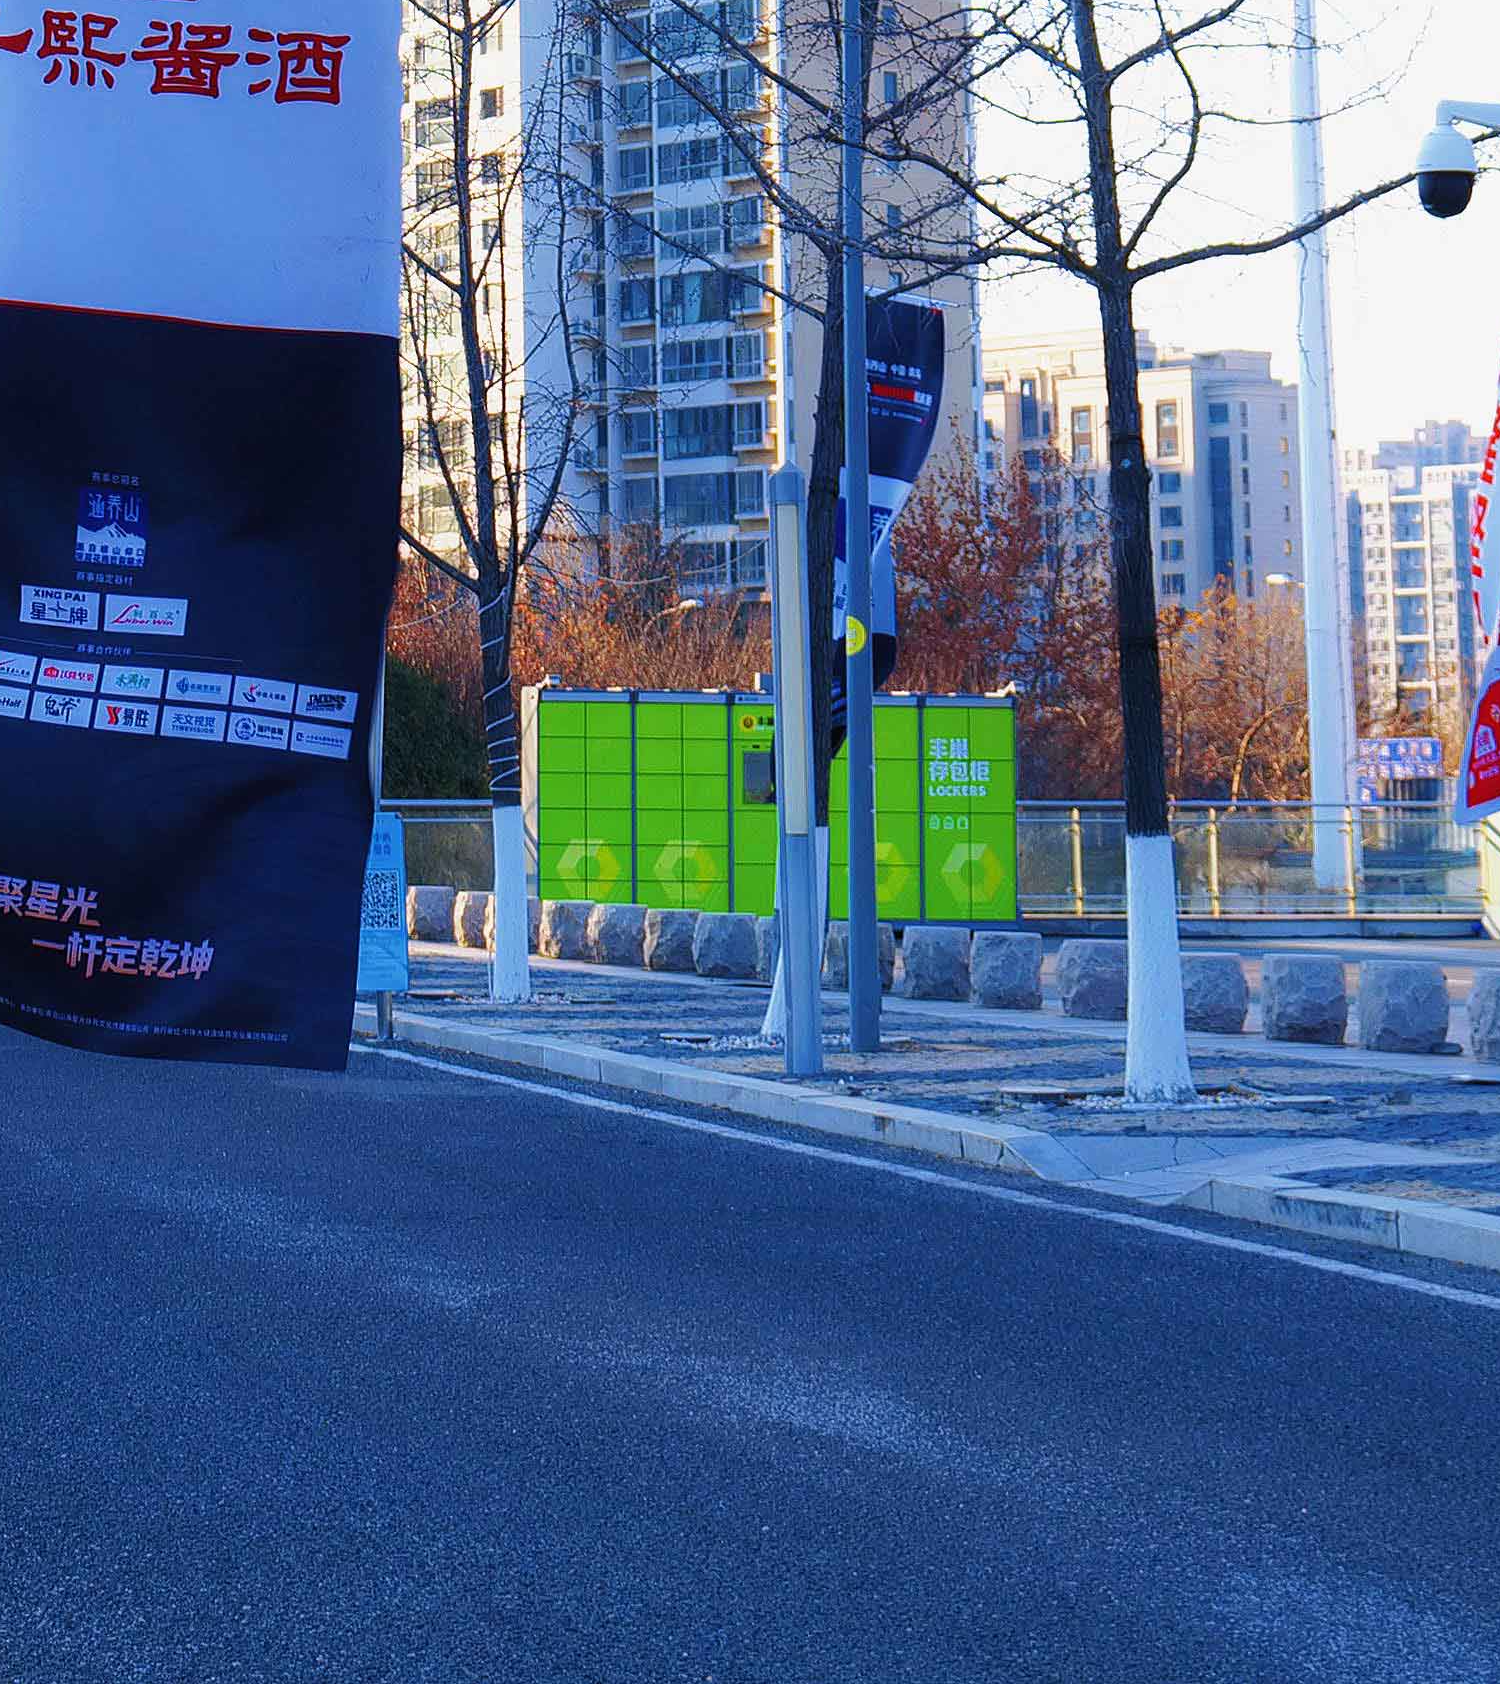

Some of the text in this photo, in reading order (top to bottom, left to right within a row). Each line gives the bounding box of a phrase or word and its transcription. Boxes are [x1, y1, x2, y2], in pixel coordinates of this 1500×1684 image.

[928, 760, 990, 782] 存包柜
[928, 784, 987, 798] LOCKERS
[31, 930, 216, 980] 一杆定乾坤
